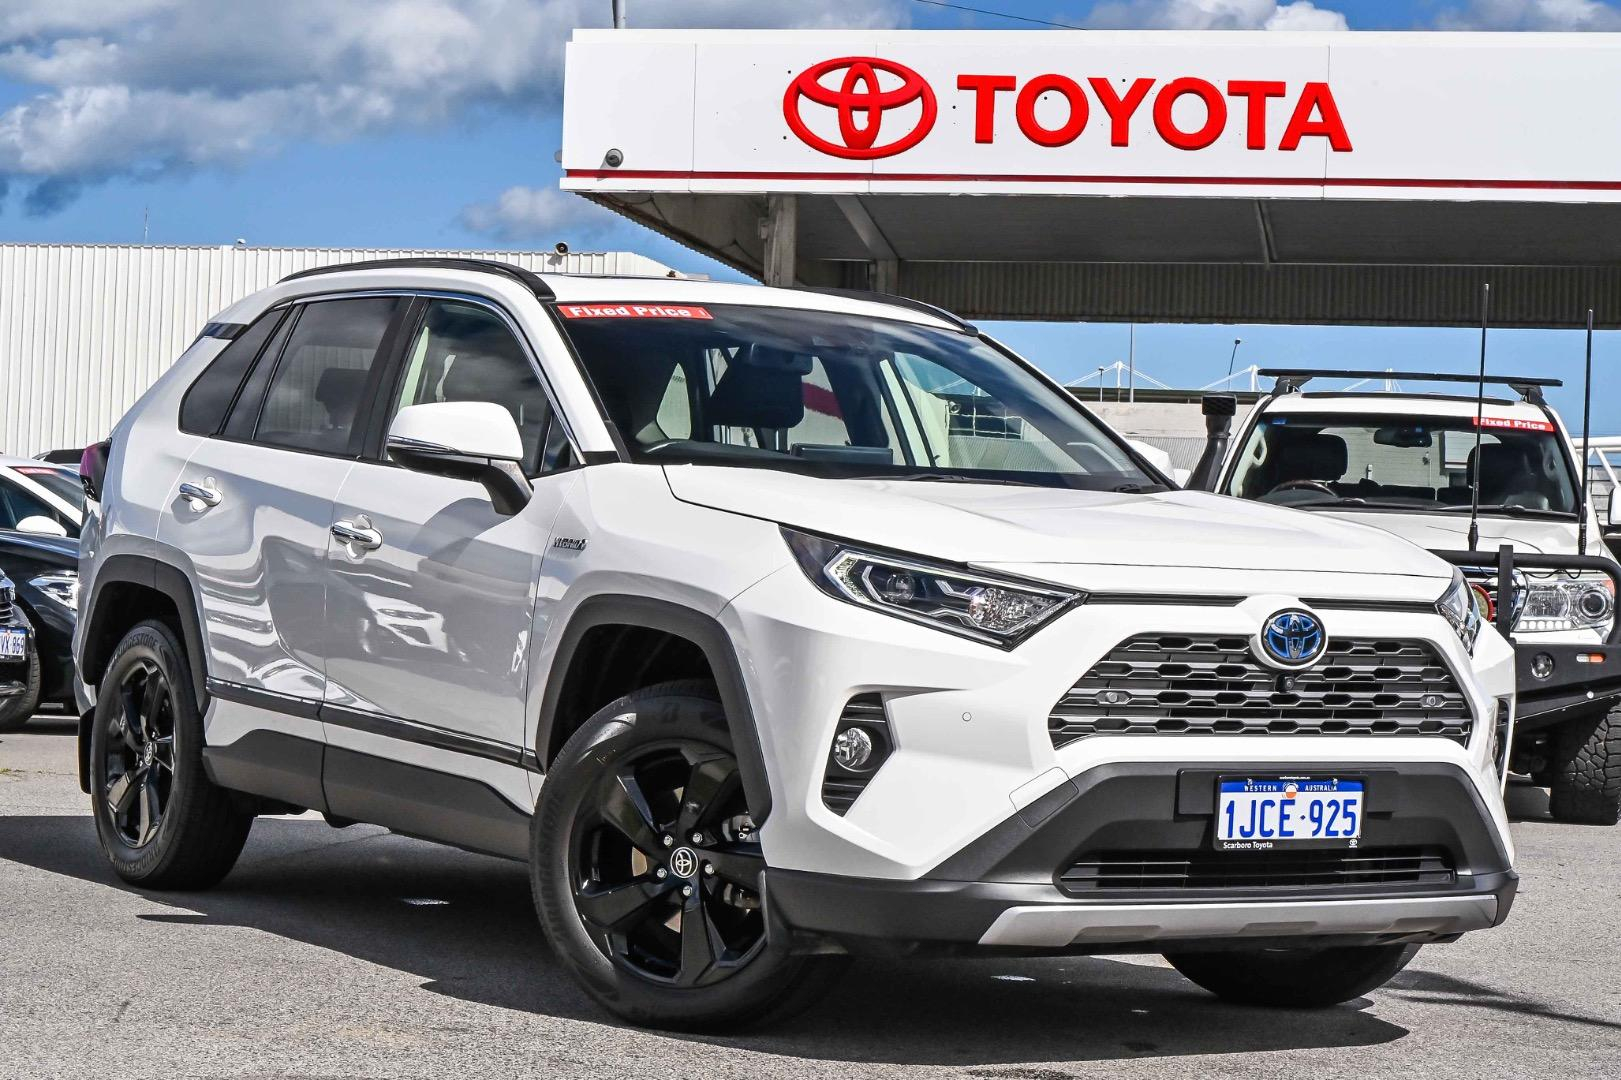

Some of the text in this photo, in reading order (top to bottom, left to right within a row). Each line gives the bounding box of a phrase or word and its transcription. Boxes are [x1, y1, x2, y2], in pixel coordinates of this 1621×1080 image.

[956, 73, 1353, 152] TOYOTA
[569, 305, 692, 318] Fixed Price
[1480, 417, 1546, 430] Fixed Price
